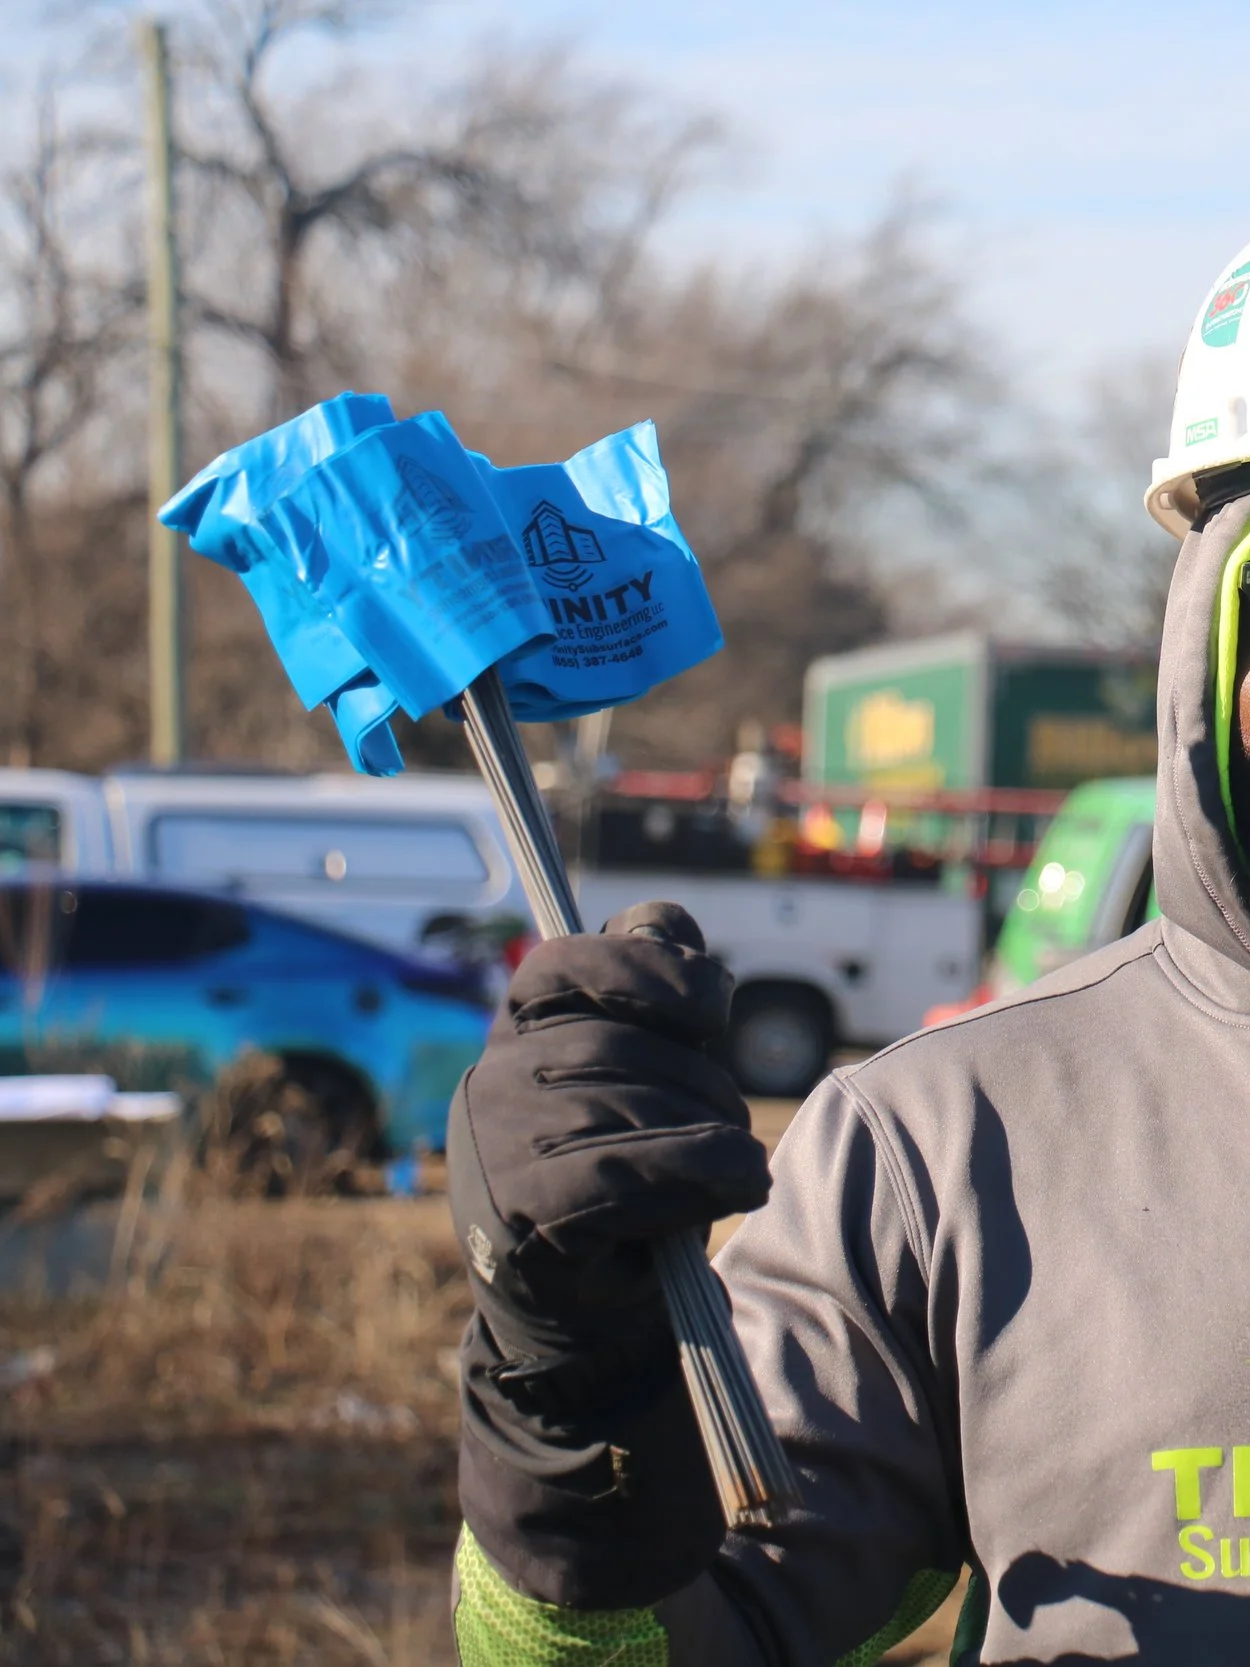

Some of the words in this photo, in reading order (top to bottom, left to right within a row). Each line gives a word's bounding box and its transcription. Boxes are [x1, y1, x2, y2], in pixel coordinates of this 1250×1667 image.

[1186, 420, 1216, 445] MSA
[543, 570, 653, 625] INITY
[577, 606, 652, 641] Engineering
